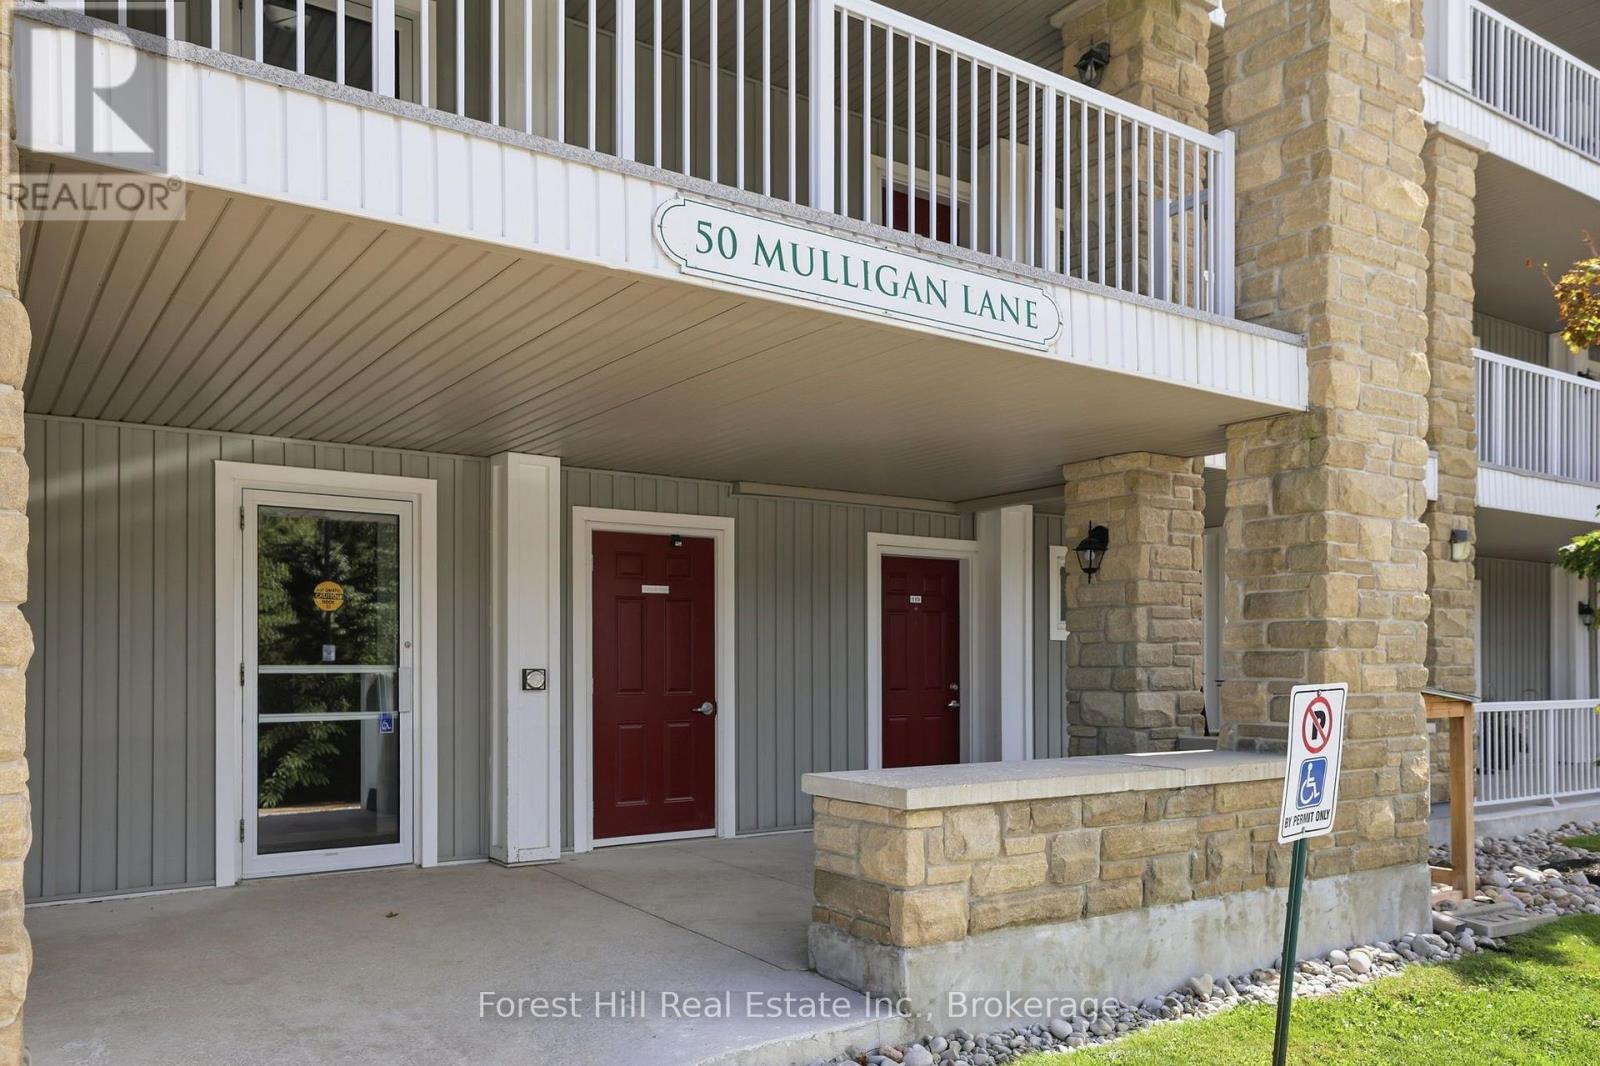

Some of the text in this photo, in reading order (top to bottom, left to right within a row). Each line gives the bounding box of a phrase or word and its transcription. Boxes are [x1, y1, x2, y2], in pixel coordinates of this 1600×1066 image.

[695, 220, 1039, 330] 50 MULLIGAN LANE
[1284, 809, 1331, 829] BY PERMIT ONLY
